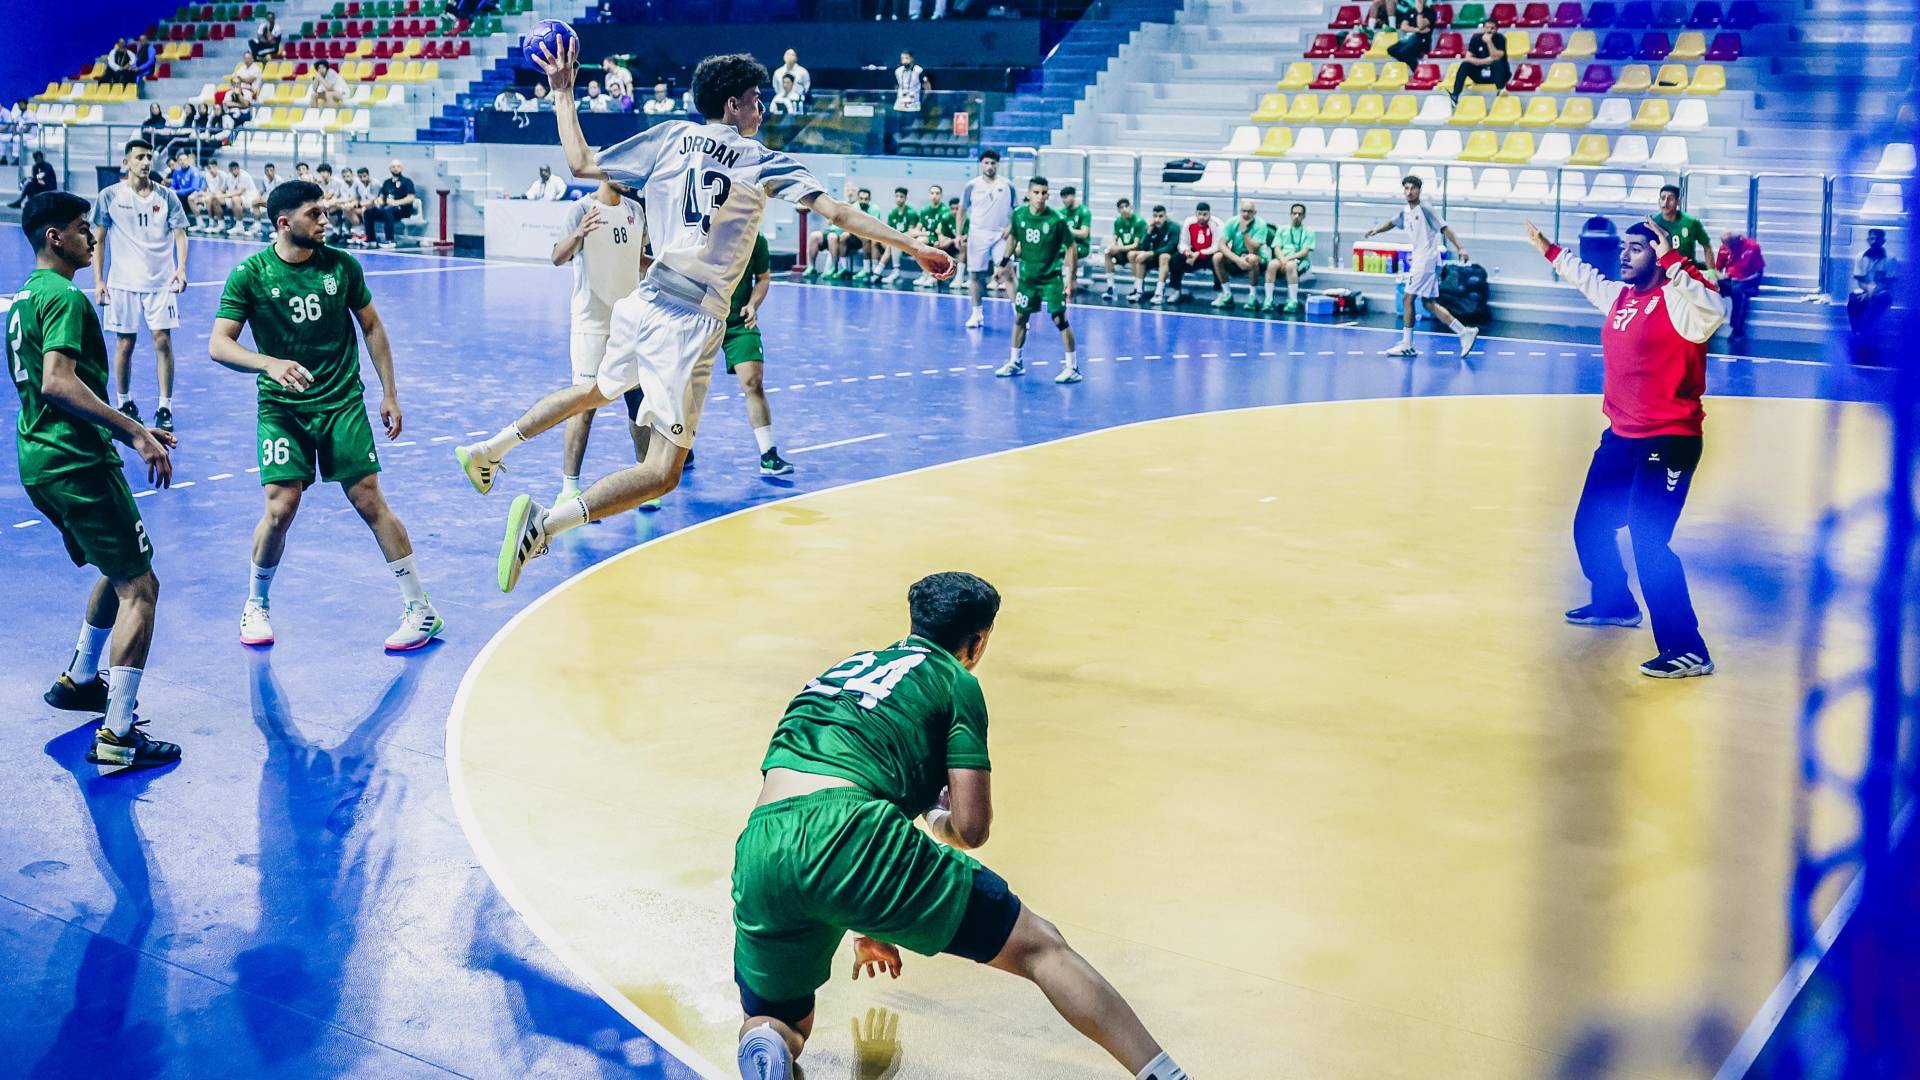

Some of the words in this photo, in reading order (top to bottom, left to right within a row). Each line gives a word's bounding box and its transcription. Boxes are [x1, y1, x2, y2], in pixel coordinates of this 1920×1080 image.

[679, 136, 740, 169] JORDAN
[138, 213, 148, 227] 11
[613, 227, 628, 244] 88
[1026, 228, 1041, 244] 88
[289, 293, 322, 323] 36
[1015, 291, 1029, 308] 88
[1612, 307, 1639, 332] 37
[9, 308, 29, 383] 2
[262, 437, 291, 466] 36
[135, 519, 149, 553] 2
[803, 651, 927, 710] 24
